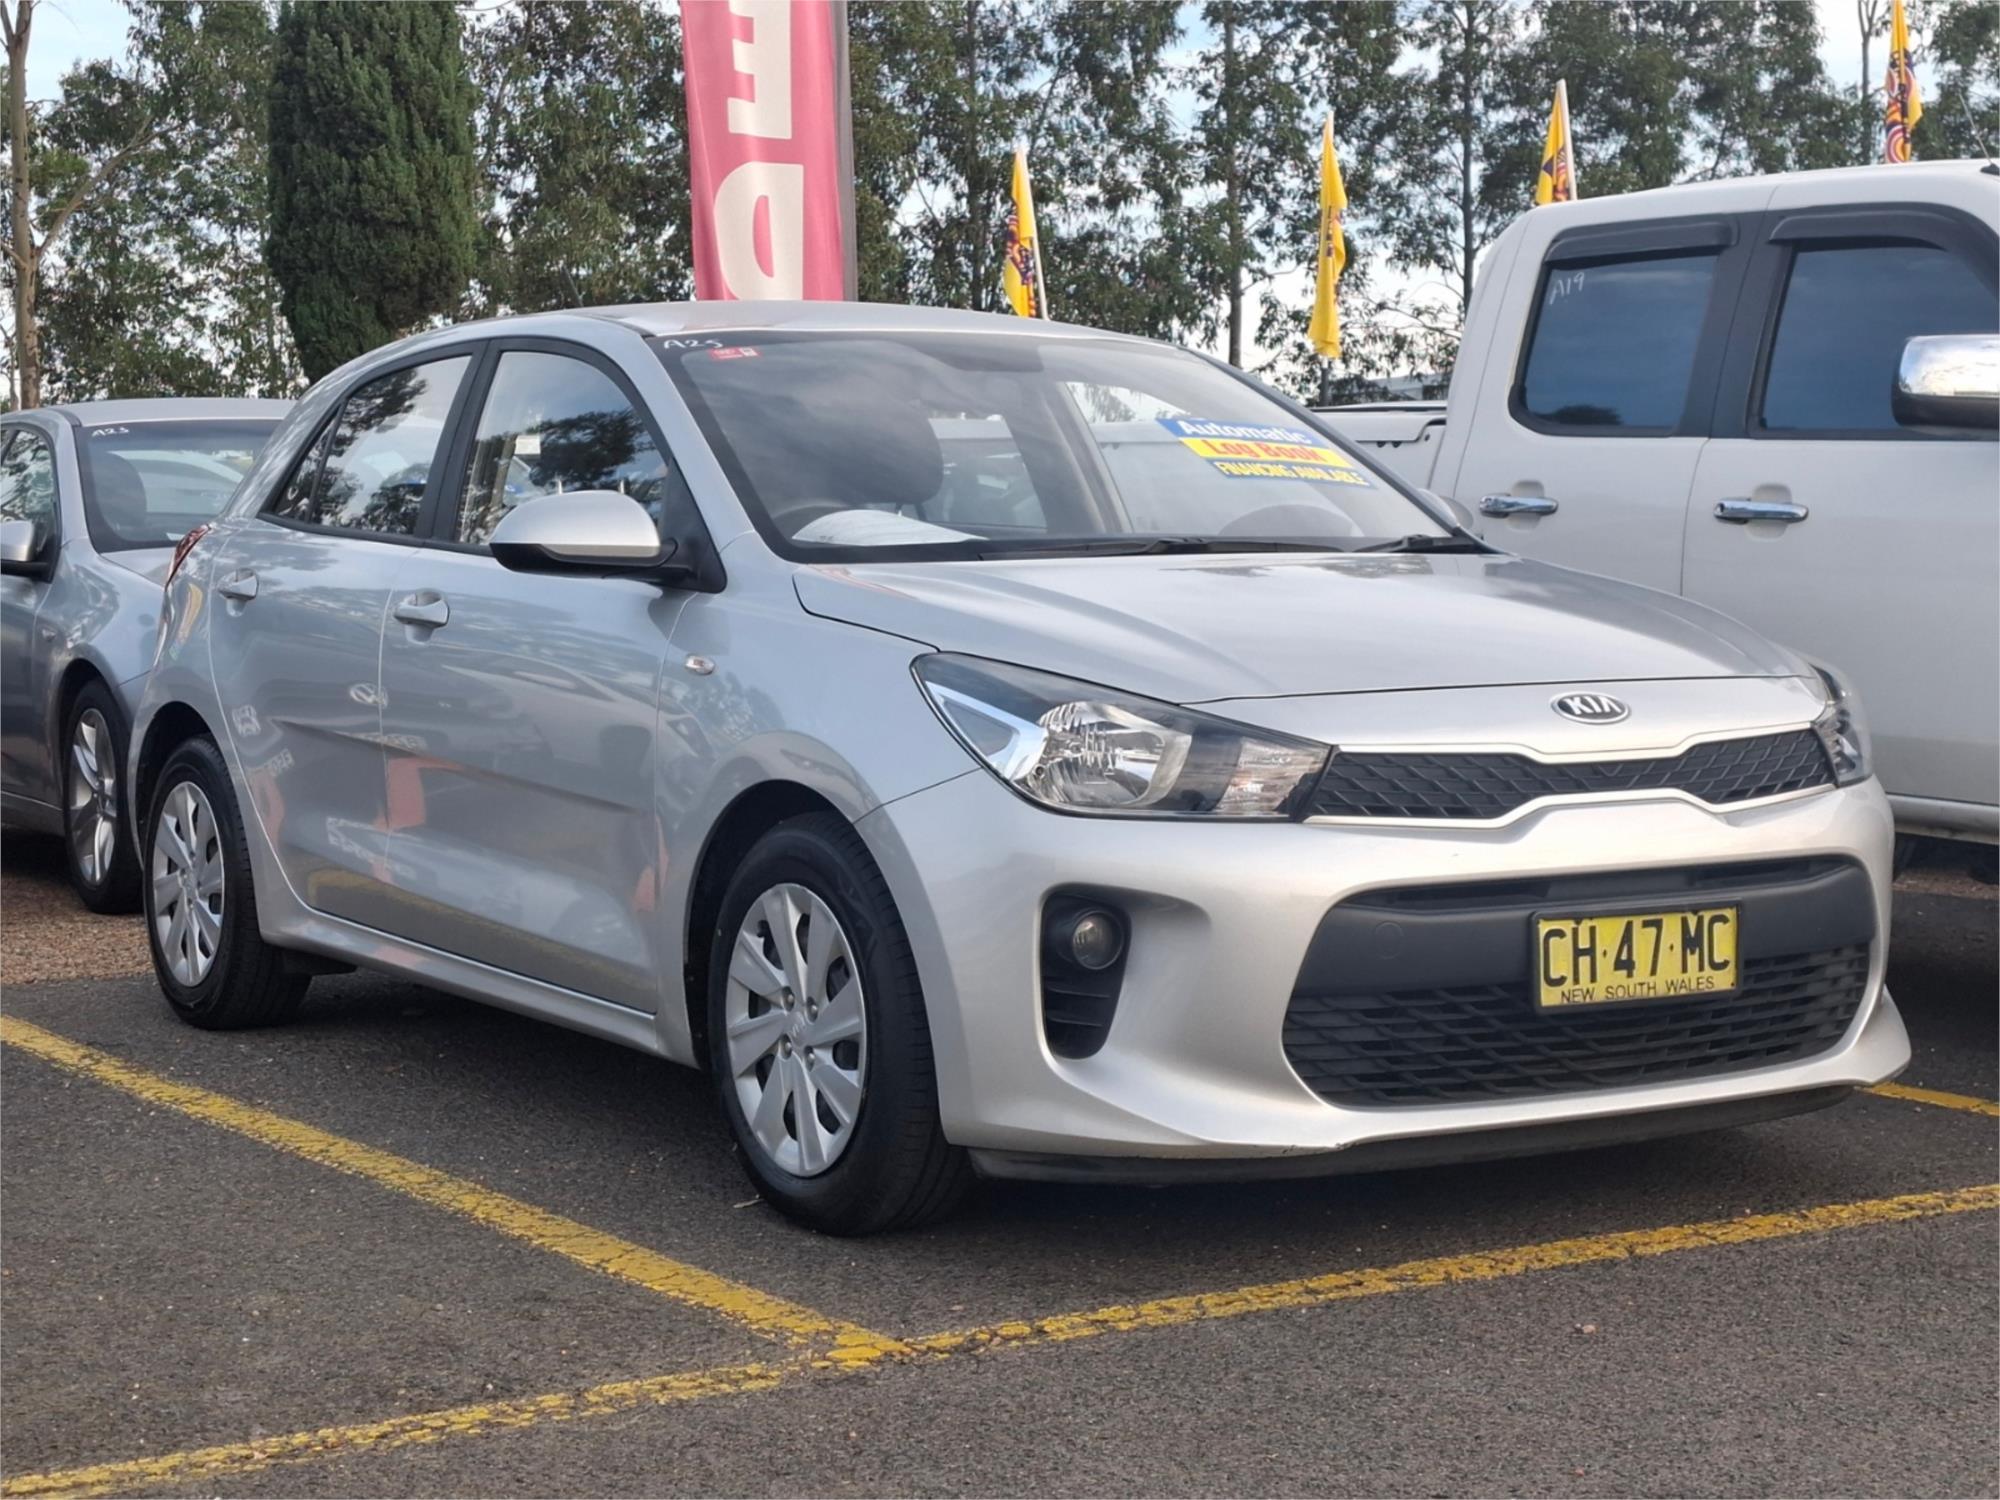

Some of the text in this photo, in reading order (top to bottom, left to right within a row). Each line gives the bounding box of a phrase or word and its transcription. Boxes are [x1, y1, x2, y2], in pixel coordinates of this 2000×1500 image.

[1549, 271, 1585, 304] A19
[1178, 420, 1306, 443] Automatic
[1203, 440, 1326, 462] Log Book
[1563, 695, 1623, 715] KIA
[1561, 976, 1714, 1004] NEW SOUTH WALES
